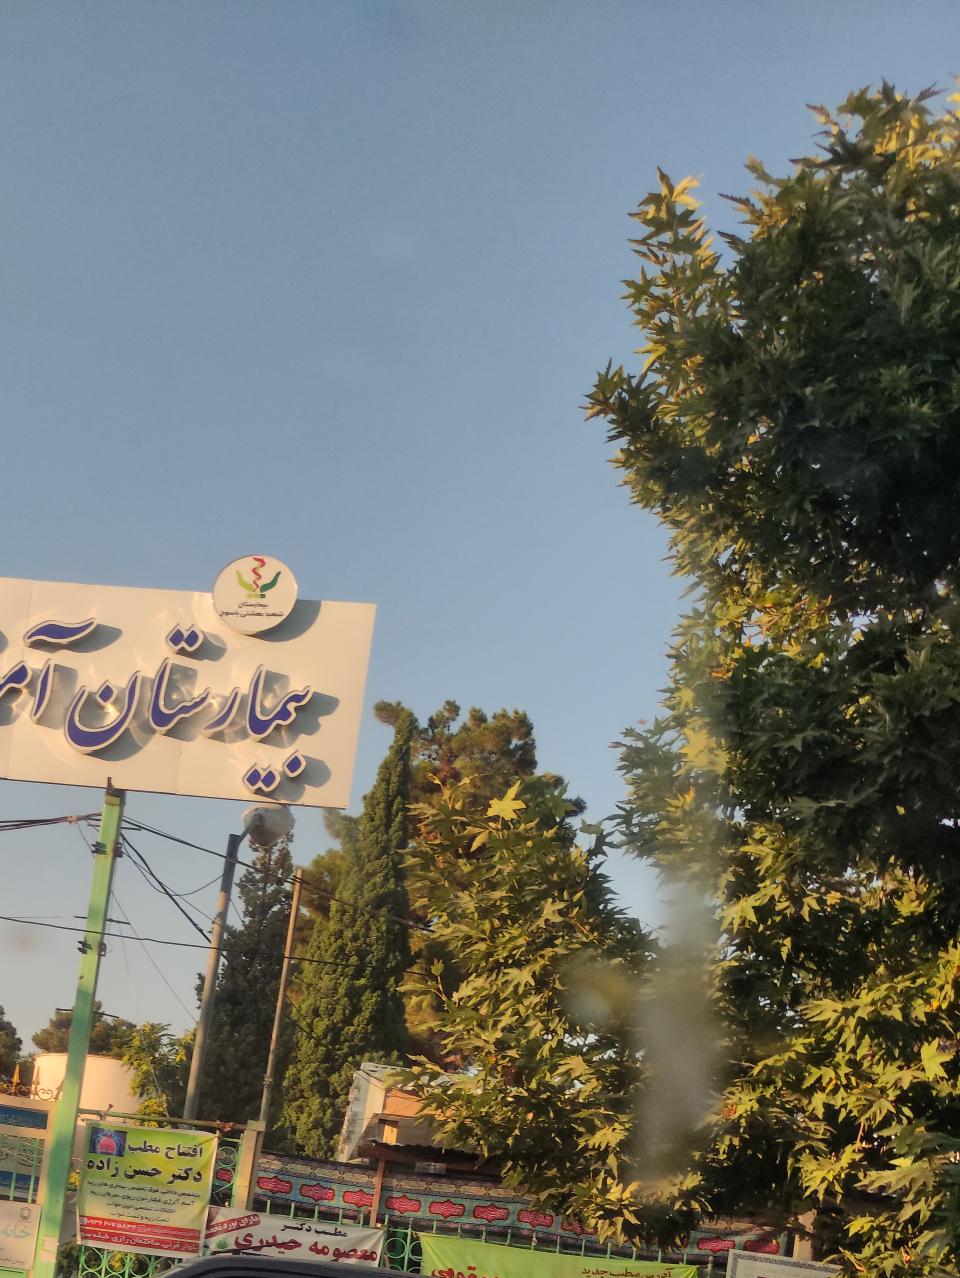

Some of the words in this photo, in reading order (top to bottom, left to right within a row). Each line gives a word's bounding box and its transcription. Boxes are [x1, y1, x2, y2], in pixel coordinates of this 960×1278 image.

[64, 623, 314, 793] بیمارستان
[127, 1139, 161, 1155] مطب
[164, 1143, 203, 1159] افتتاح
[86, 1157, 120, 1178] زاده
[123, 1165, 162, 1179] حسن
[166, 1167, 203, 1185] دکتر
[2, 1222, 33, 1239] خانه
[280, 1223, 312, 1233] دکتر
[314, 1227, 348, 1239] مطب
[234, 1232, 302, 1254] حیدری
[308, 1241, 378, 1262] معصومه
[581, 1267, 609, 1278] جدید
